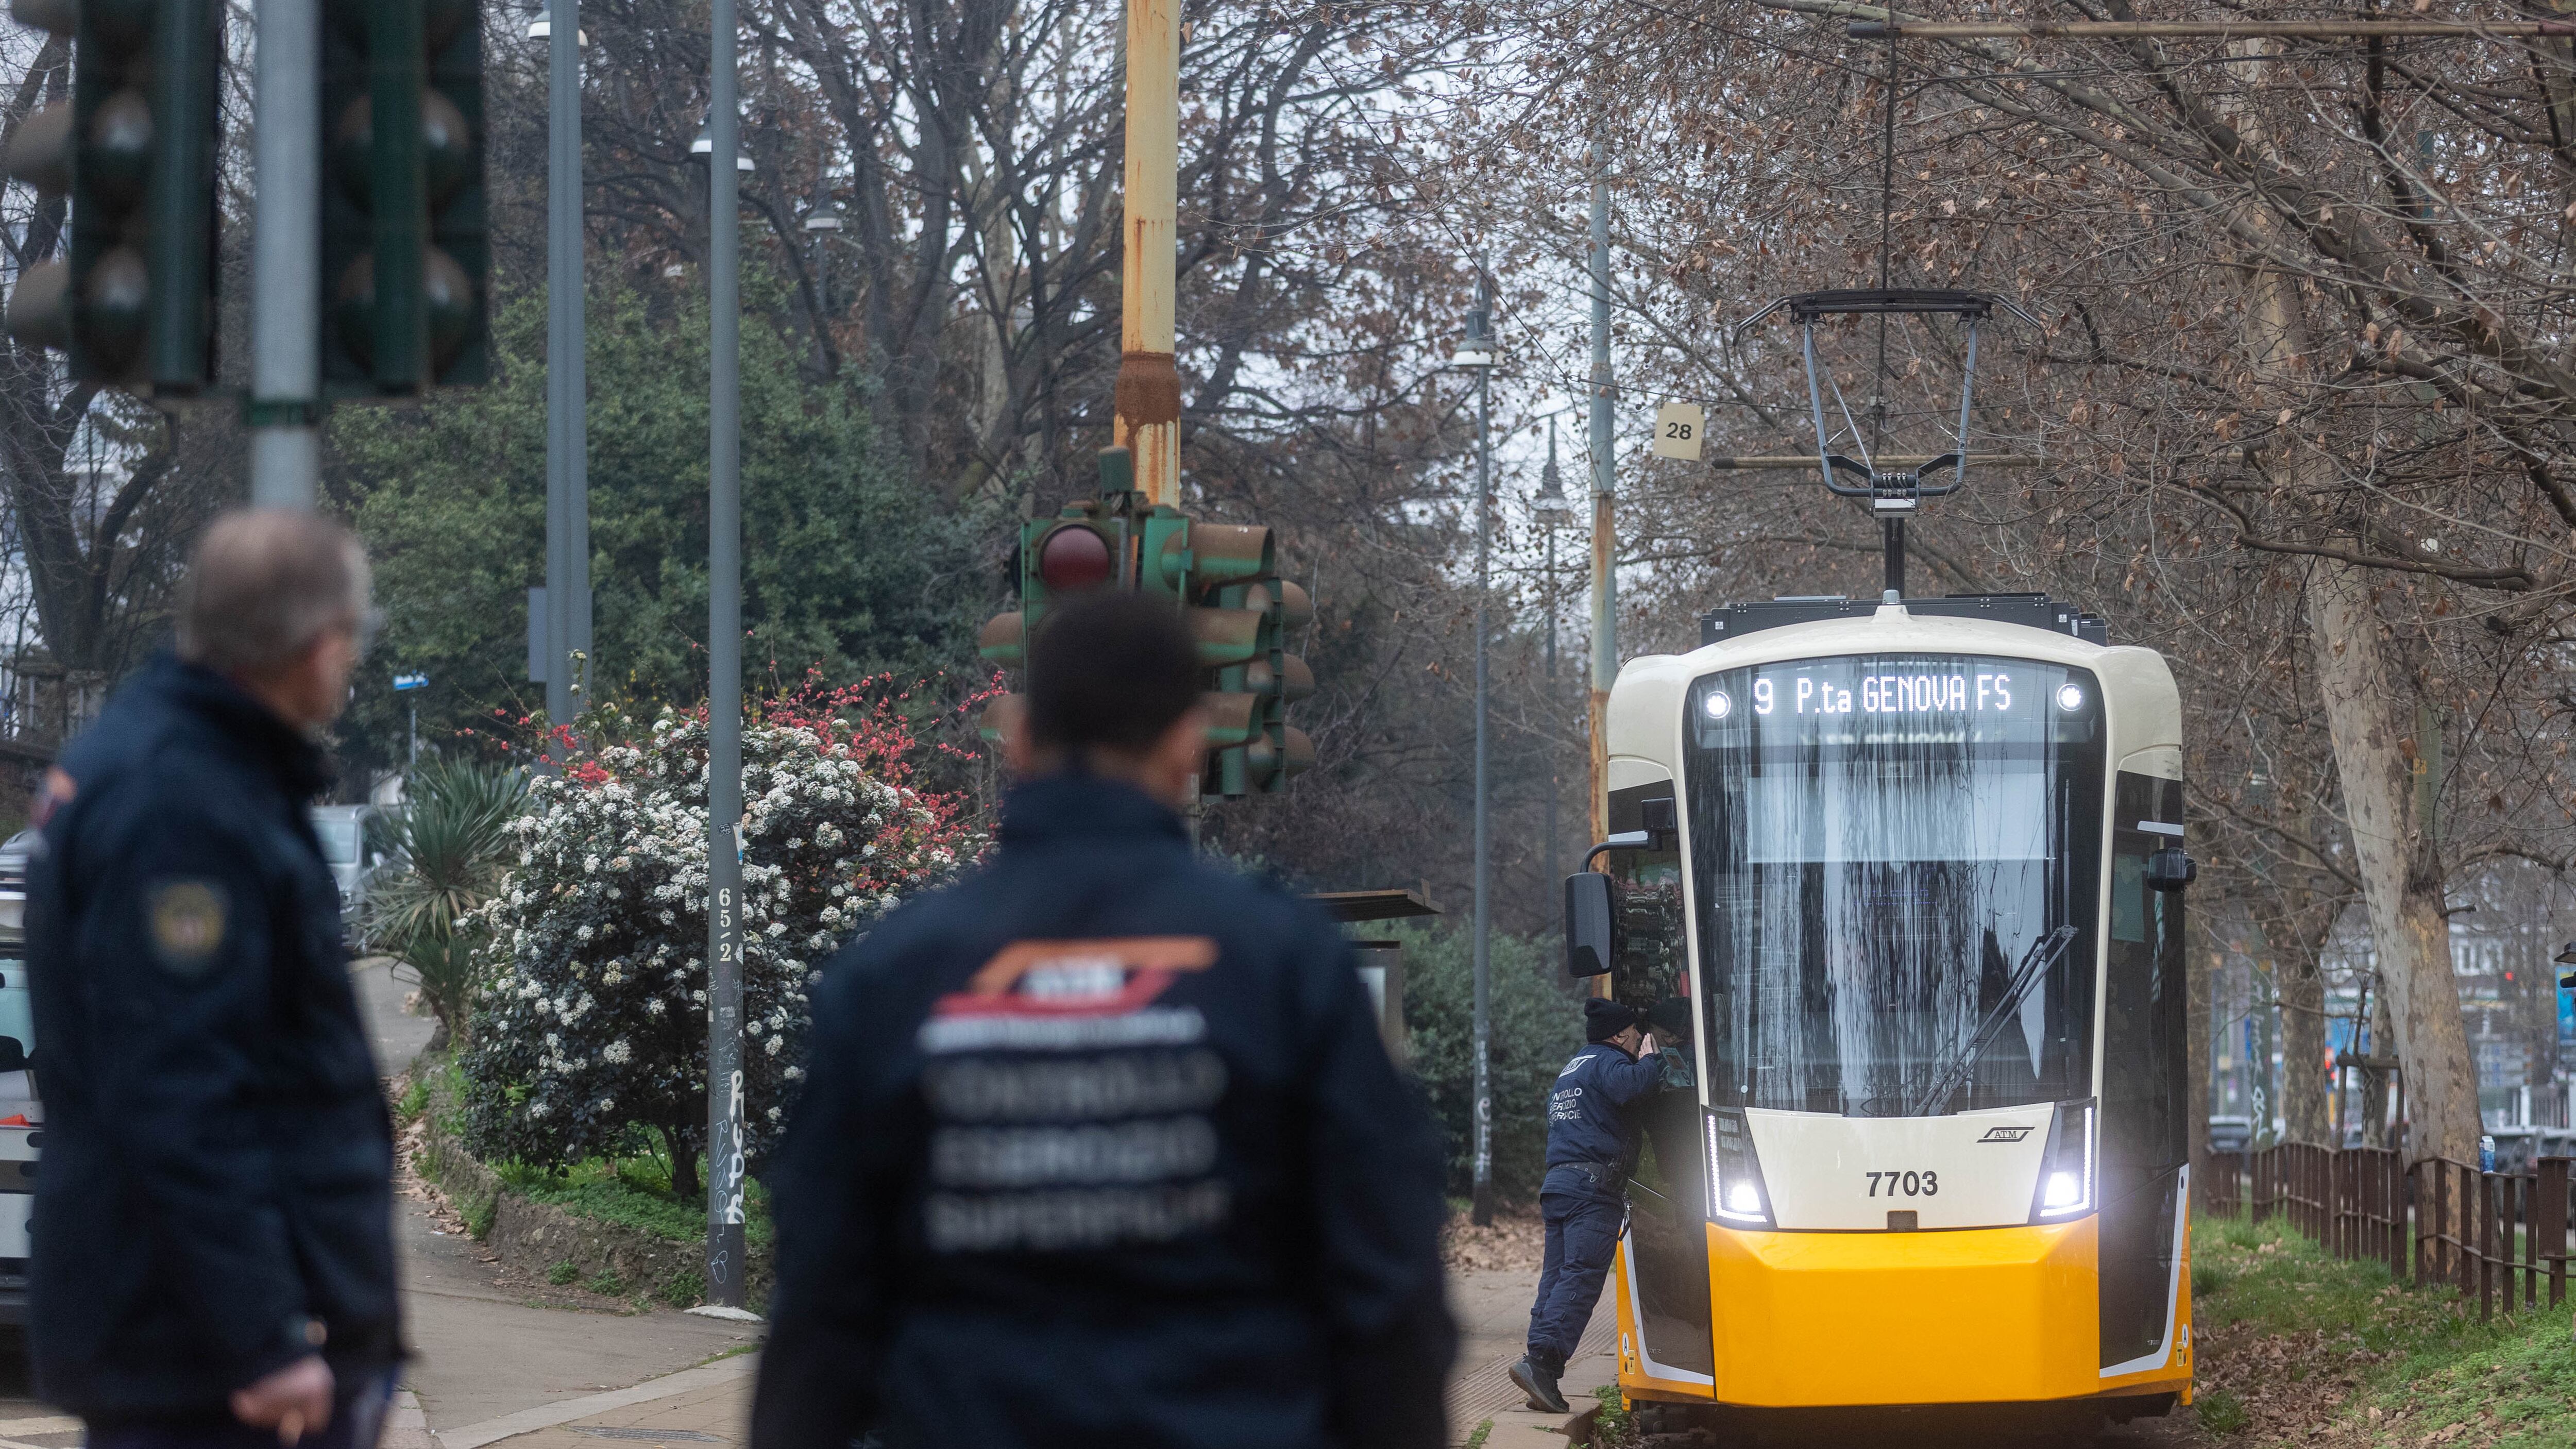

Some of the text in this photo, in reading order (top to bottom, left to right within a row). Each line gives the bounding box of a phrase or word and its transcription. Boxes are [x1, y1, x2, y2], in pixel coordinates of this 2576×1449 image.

[1666, 422, 1692, 440] 28
[1753, 674, 2011, 715] 9 P.ta GENOVA FS
[1994, 1131, 2018, 1139] ATM
[1866, 1170, 1938, 1197] 7703
[2183, 1328, 2187, 1343] A
[1624, 1337, 1628, 1352] A
